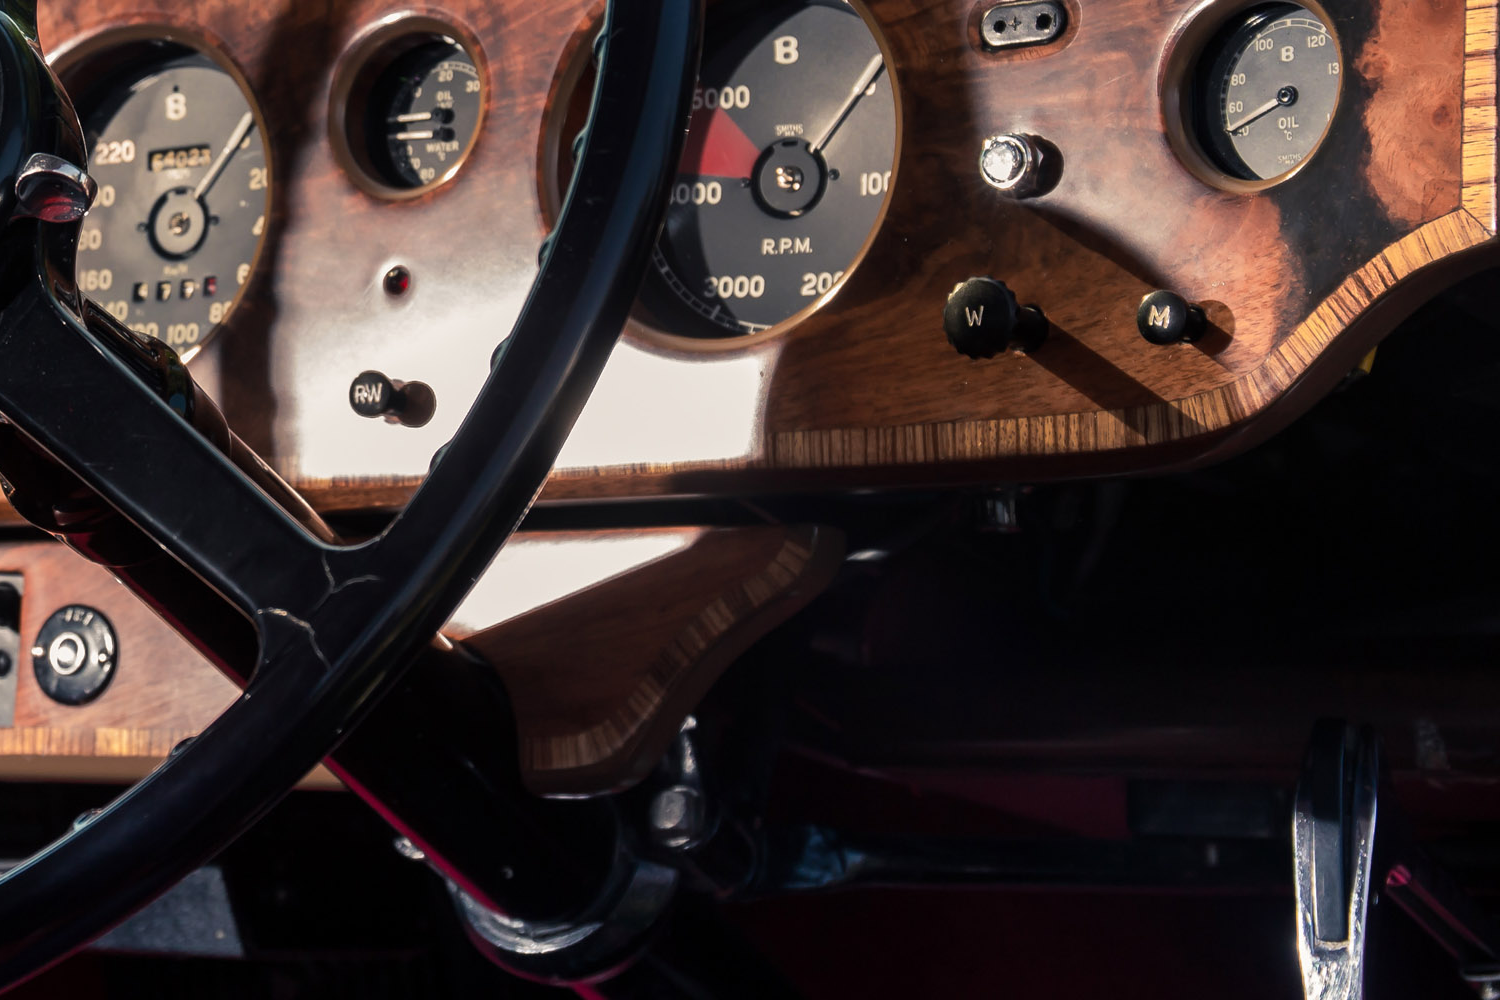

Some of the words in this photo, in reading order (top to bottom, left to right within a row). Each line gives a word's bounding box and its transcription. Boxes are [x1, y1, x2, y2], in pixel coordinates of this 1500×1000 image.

[773, 36, 800, 65] B
[1255, 38, 1274, 51] 100
[1307, 34, 1326, 48] 120
[1231, 73, 1246, 86] 80
[165, 92, 188, 121] B
[1229, 101, 1244, 113] 60
[1278, 116, 1299, 129] OIL
[94, 139, 136, 165] 220
[426, 141, 460, 153] WATER
[761, 237, 813, 255] R.P.M.
[703, 274, 766, 299] 3000
[965, 305, 984, 327] W
[1149, 305, 1171, 329] M
[167, 323, 199, 344] 100
[354, 382, 383, 404] RW
